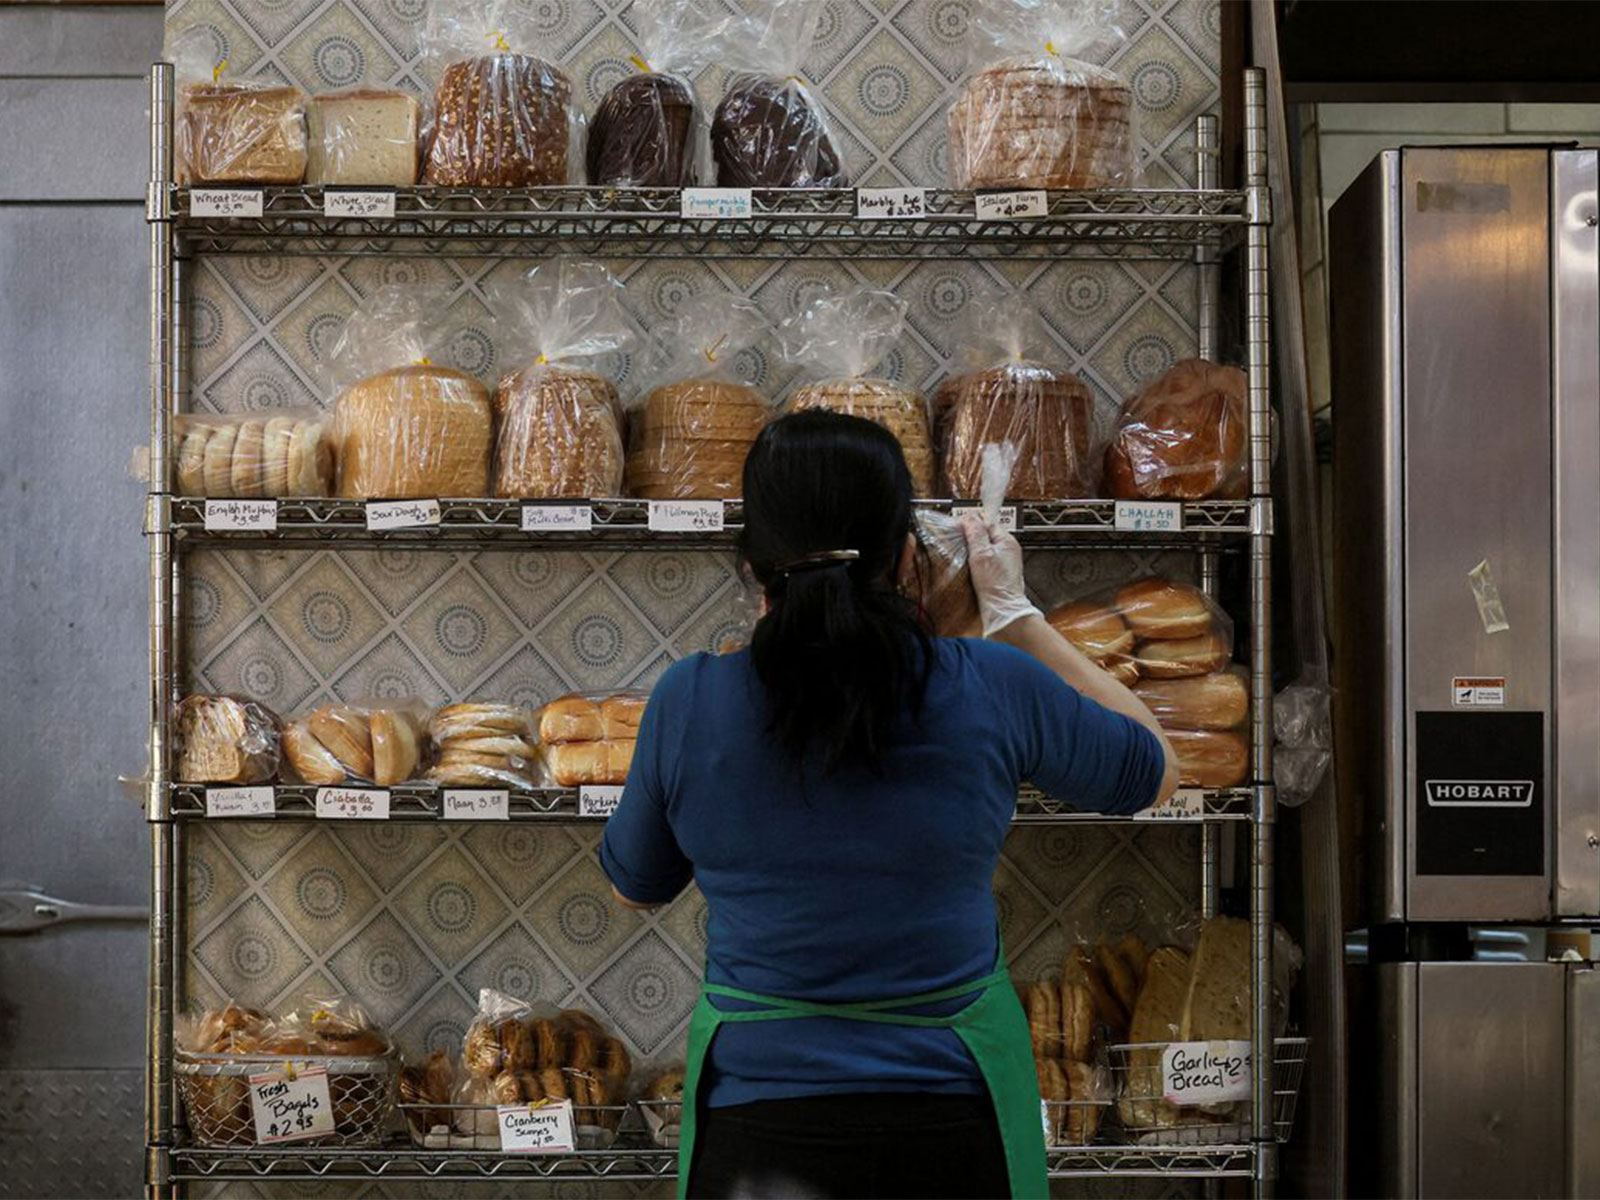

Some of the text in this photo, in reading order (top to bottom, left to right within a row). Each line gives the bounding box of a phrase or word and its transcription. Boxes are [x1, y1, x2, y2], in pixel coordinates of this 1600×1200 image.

[195, 193, 229, 203] Wheat
[860, 195, 896, 208] Marble
[1118, 507, 1175, 520] CHALLAH
[1436, 785, 1525, 799] HOBART
[1171, 1049, 1225, 1073] Garlic
[1168, 1068, 1225, 1091] Bread
[257, 1080, 290, 1100] Fresh
[268, 1092, 320, 1119] Bagels
[504, 1113, 559, 1129] Cranberry
